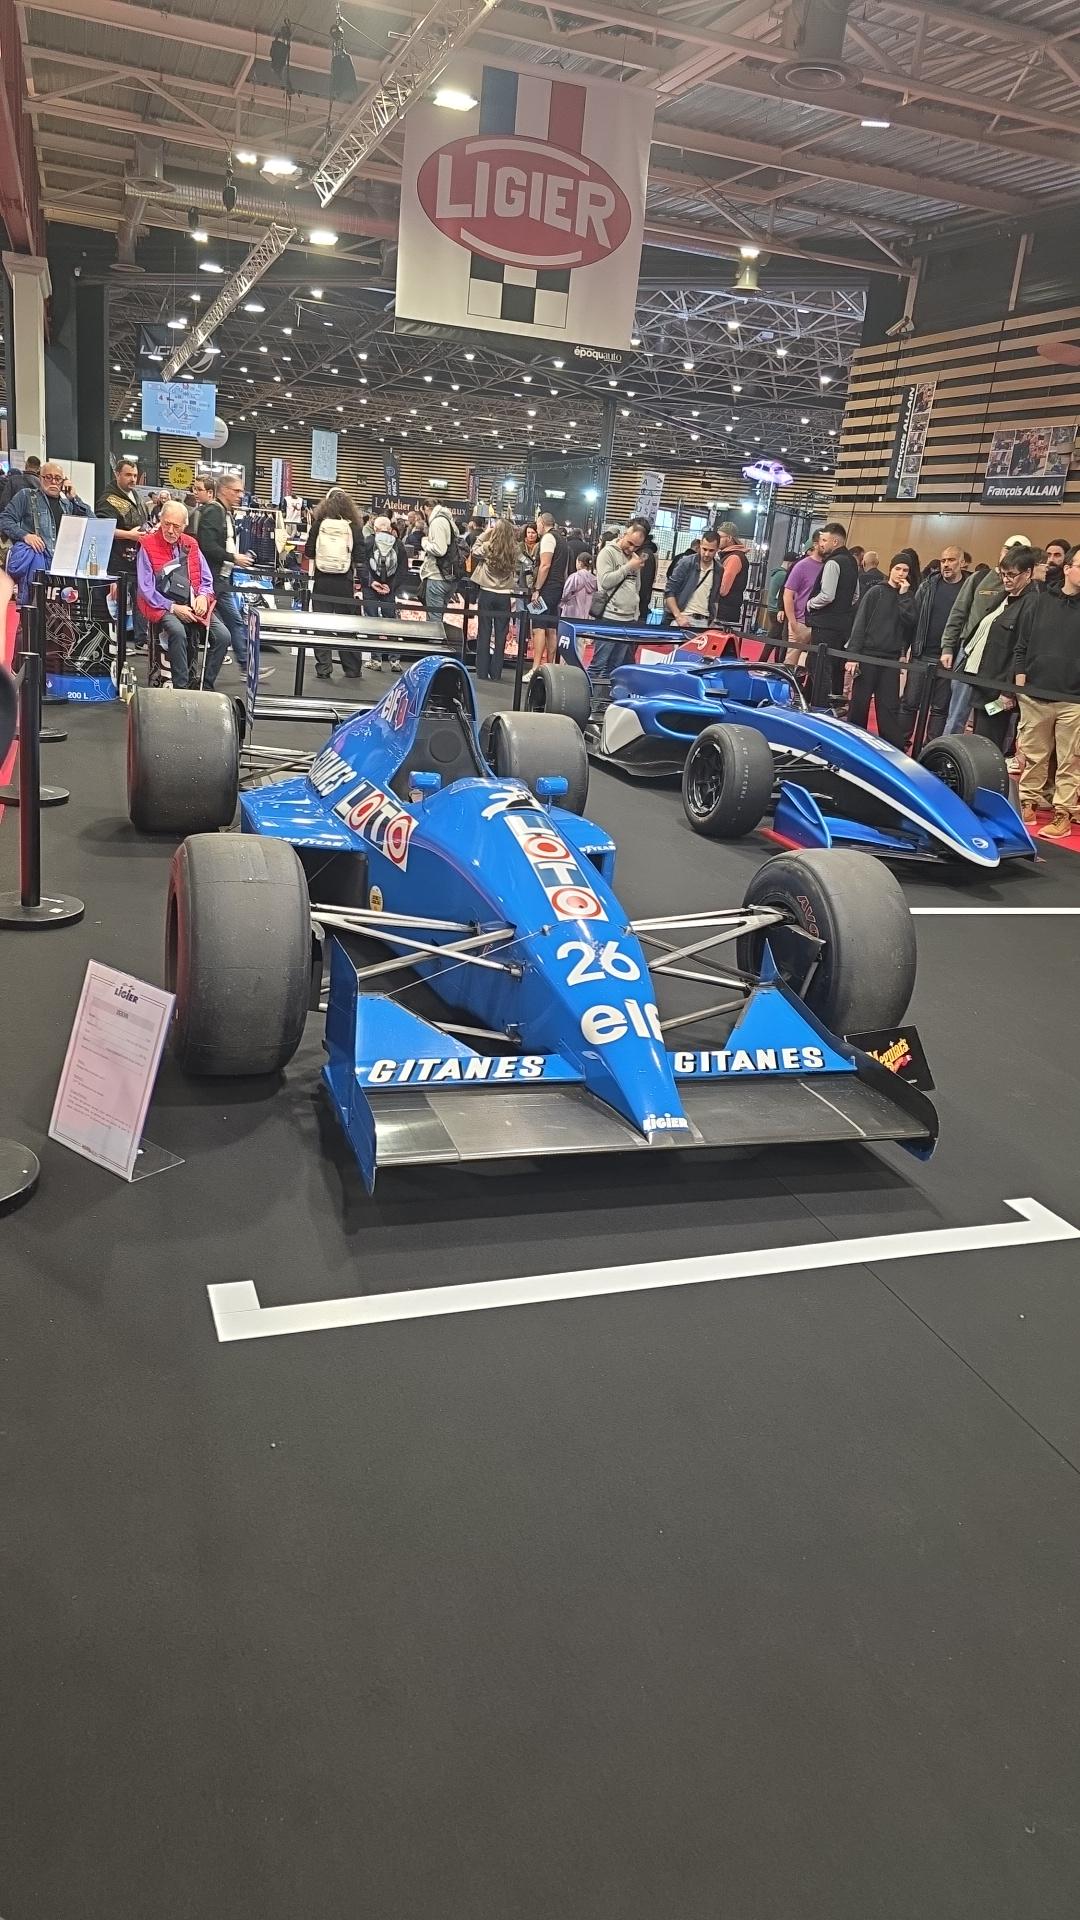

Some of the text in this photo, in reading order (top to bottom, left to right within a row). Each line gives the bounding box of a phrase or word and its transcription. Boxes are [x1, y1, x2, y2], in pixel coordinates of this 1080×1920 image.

[435, 154, 617, 249] LIGIER
[574, 346, 622, 363] époquauto
[894, 387, 916, 479] François ALLAIN
[375, 497, 411, 511] L'Atelier
[986, 485, 1061, 499] François ALLAIN
[67, 691, 89, 700] 200 L
[333, 781, 415, 867] LOTO
[506, 816, 603, 920] LOTO
[796, 895, 820, 939] AVO
[555, 940, 641, 987] 26
[367, 1054, 547, 1084] GITANES
[673, 1046, 827, 1073] GITANES
